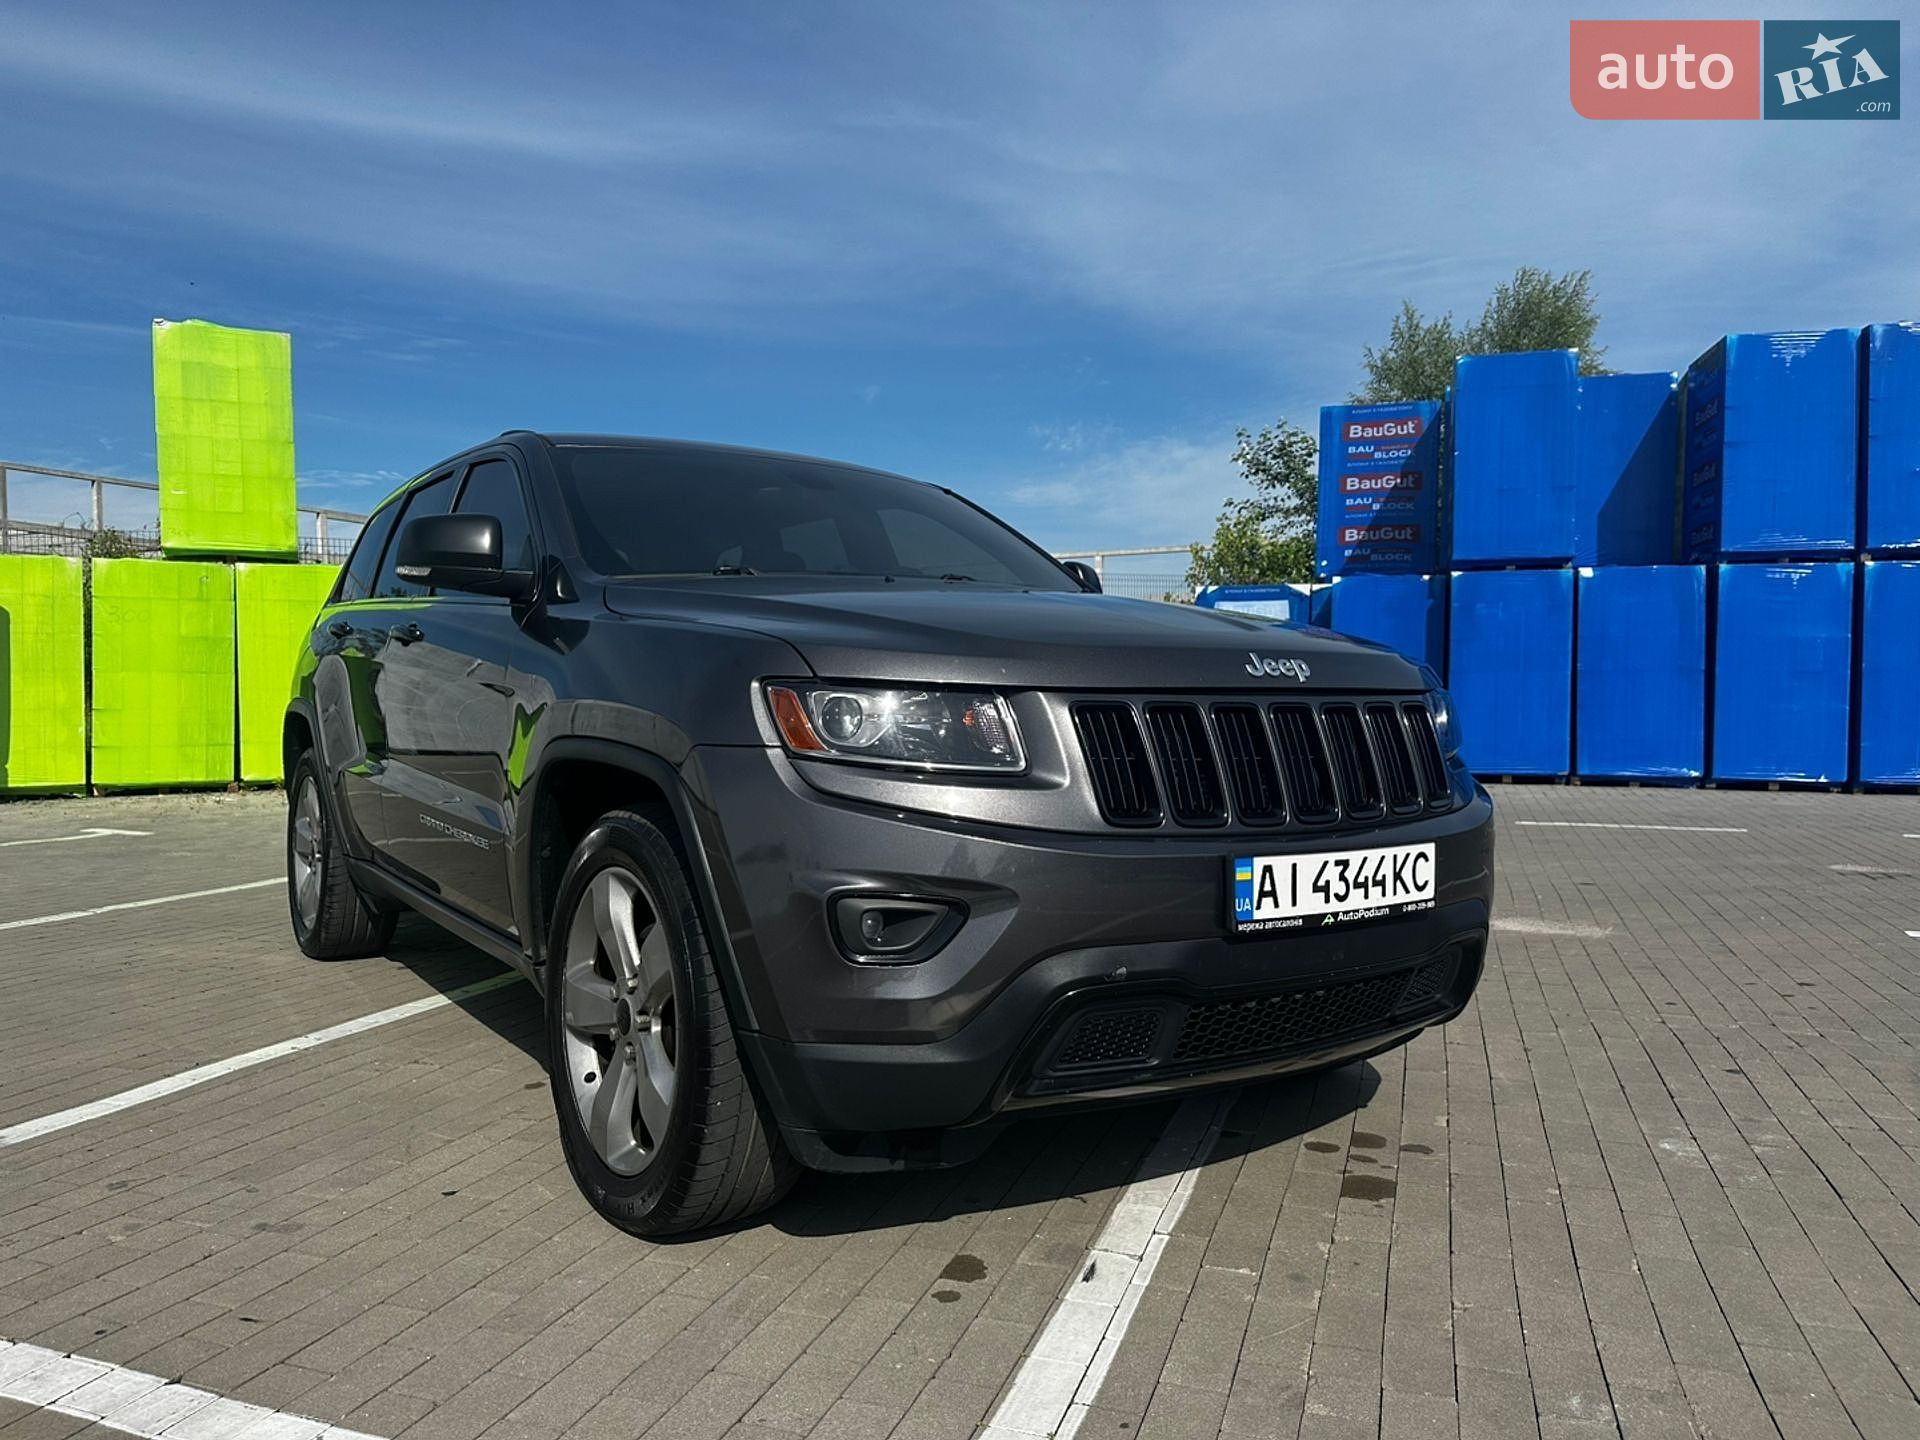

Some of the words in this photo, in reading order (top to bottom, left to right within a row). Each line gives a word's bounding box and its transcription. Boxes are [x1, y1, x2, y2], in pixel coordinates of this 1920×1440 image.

[1349, 420, 1416, 438] BauGut
[1348, 445, 1374, 454] BAU
[1346, 474, 1415, 491] BauGut
[1346, 497, 1372, 506] BAU
[1372, 502, 1415, 511] BLOCK
[1344, 526, 1413, 542] BauGut
[1344, 549, 1371, 557] BAU
[1370, 553, 1413, 562] BLOCK
[1245, 652, 1311, 683] Jeep
[1235, 898, 1251, 912] UA
[1337, 907, 1390, 922] AutoPodium
